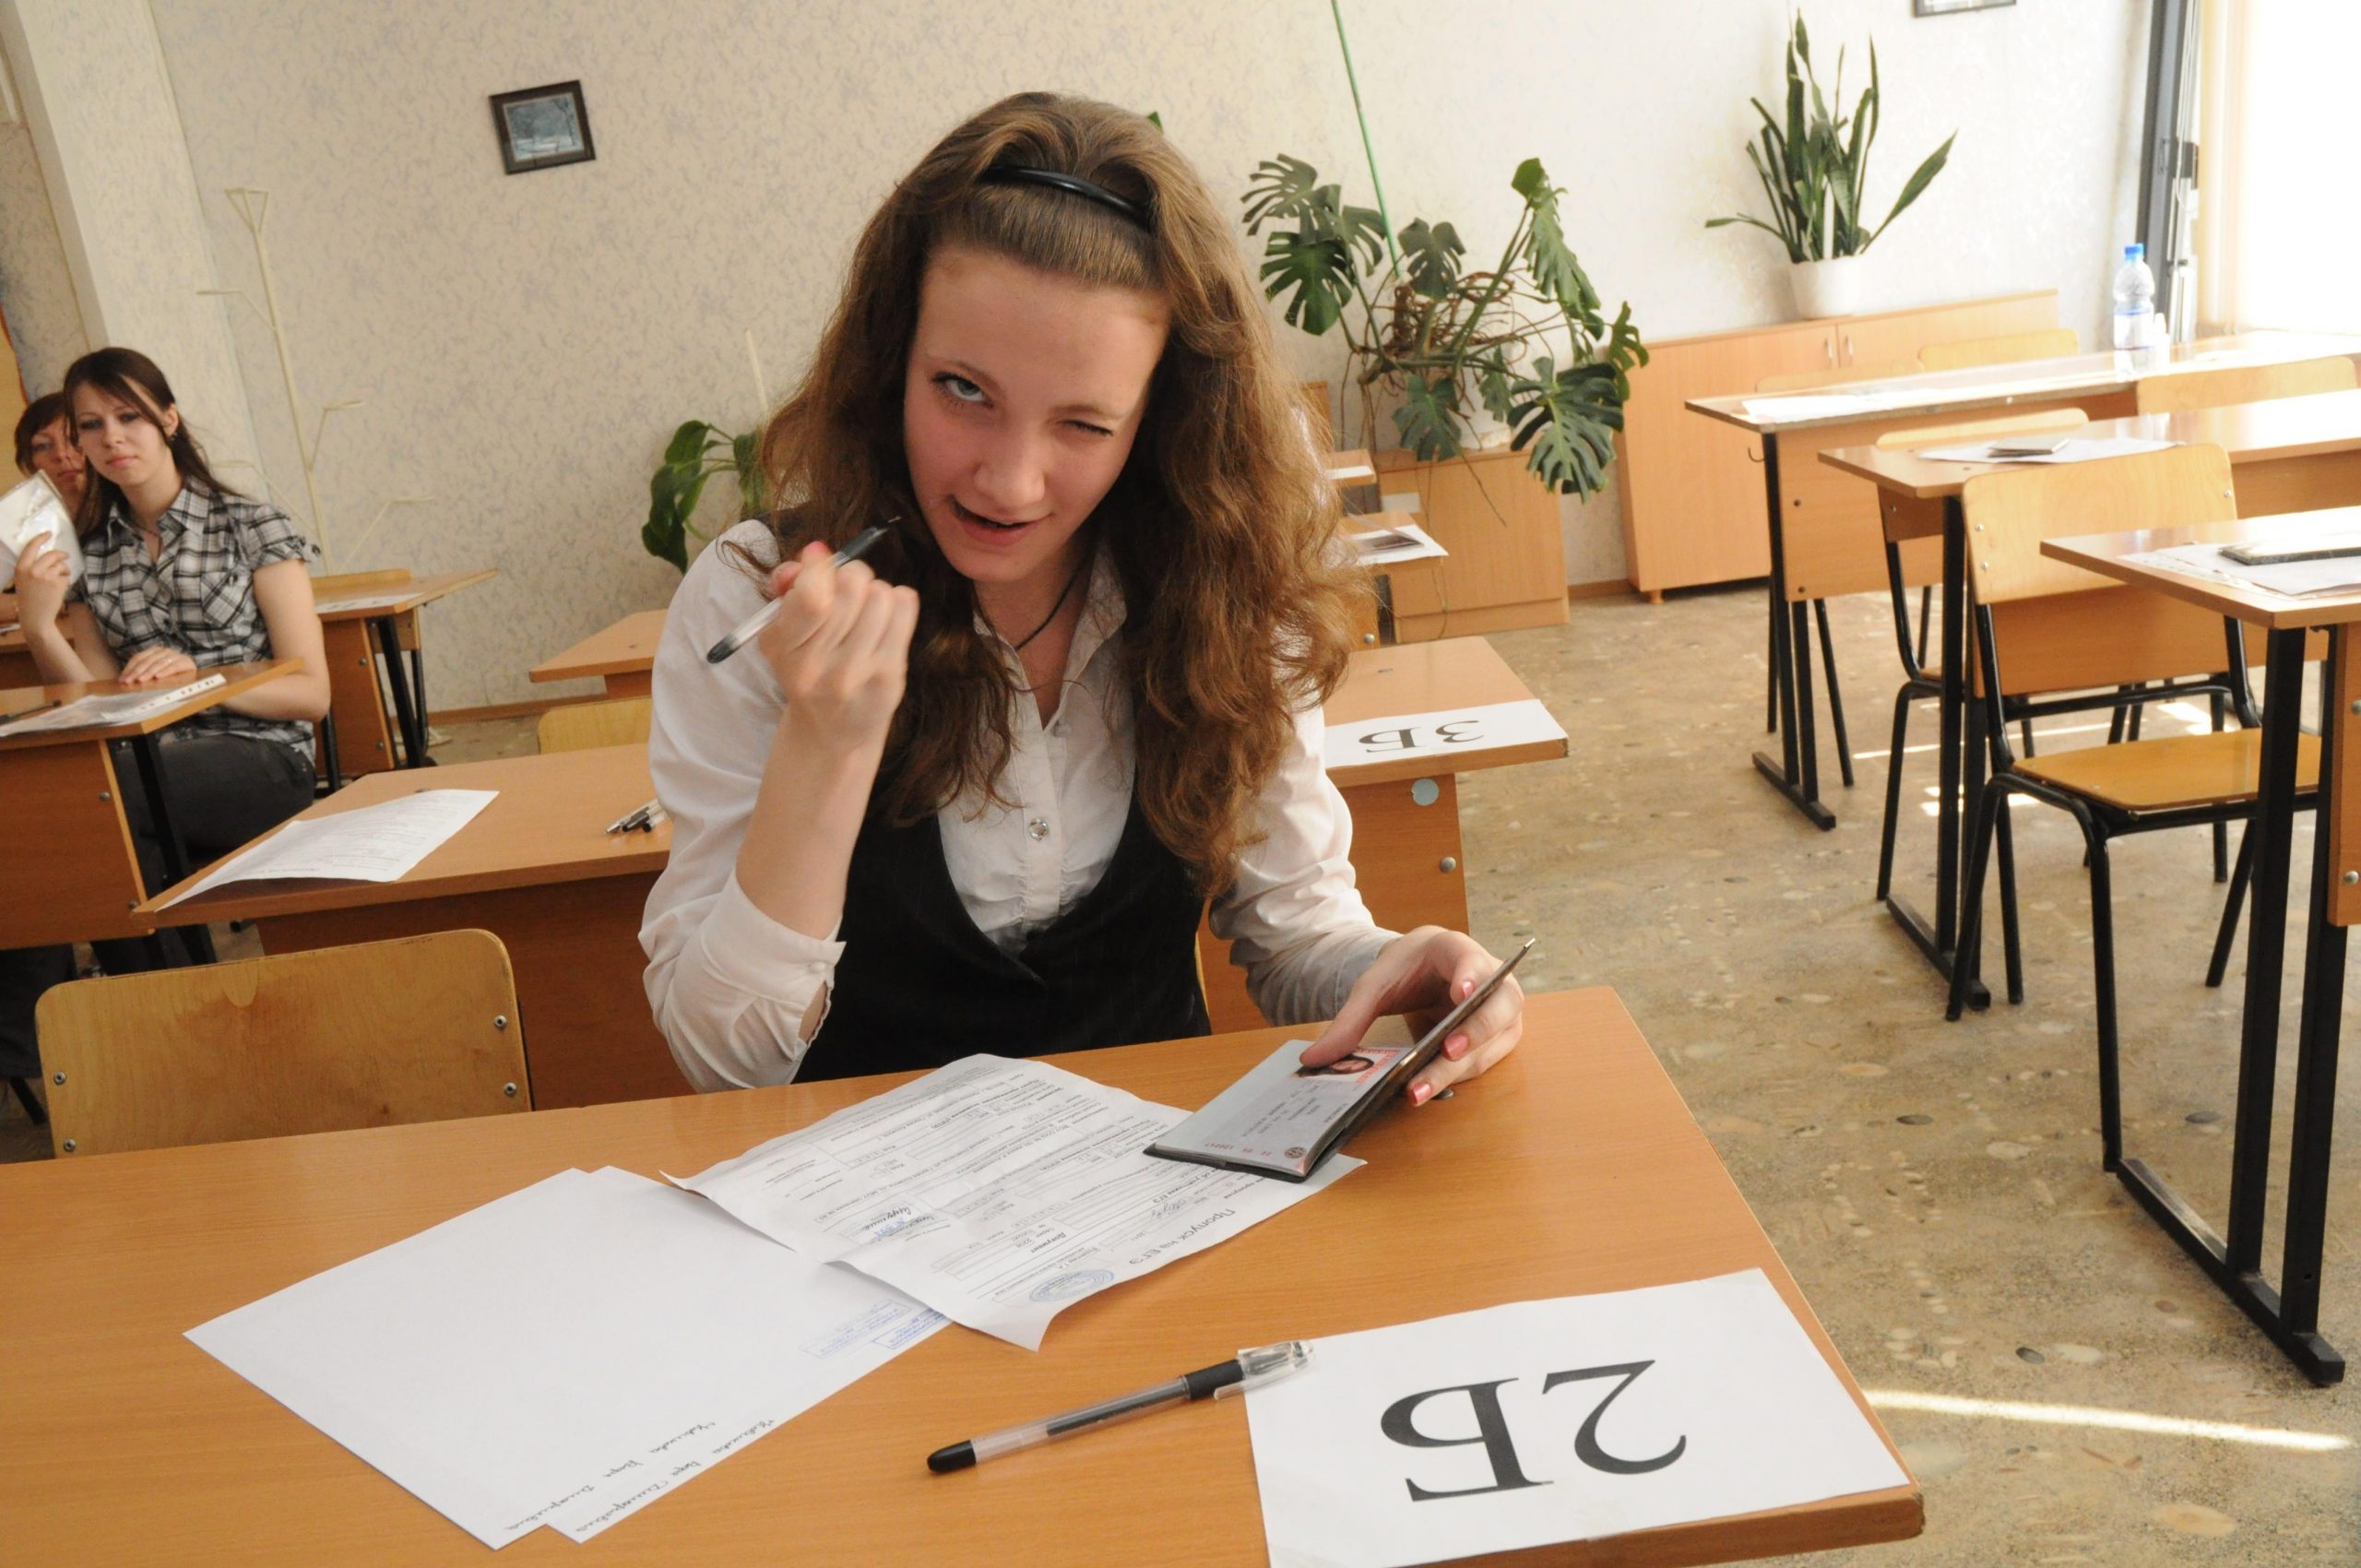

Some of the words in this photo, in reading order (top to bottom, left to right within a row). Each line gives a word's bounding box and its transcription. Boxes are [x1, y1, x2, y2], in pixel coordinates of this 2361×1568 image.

[1358, 720, 1485, 753] 3Б
[1180, 1208, 1236, 1241] Пропуск
[1128, 1248, 1161, 1265] ЕГЭ
[1158, 1240, 1178, 1250] на
[1381, 1360, 1687, 1502] 2Б
